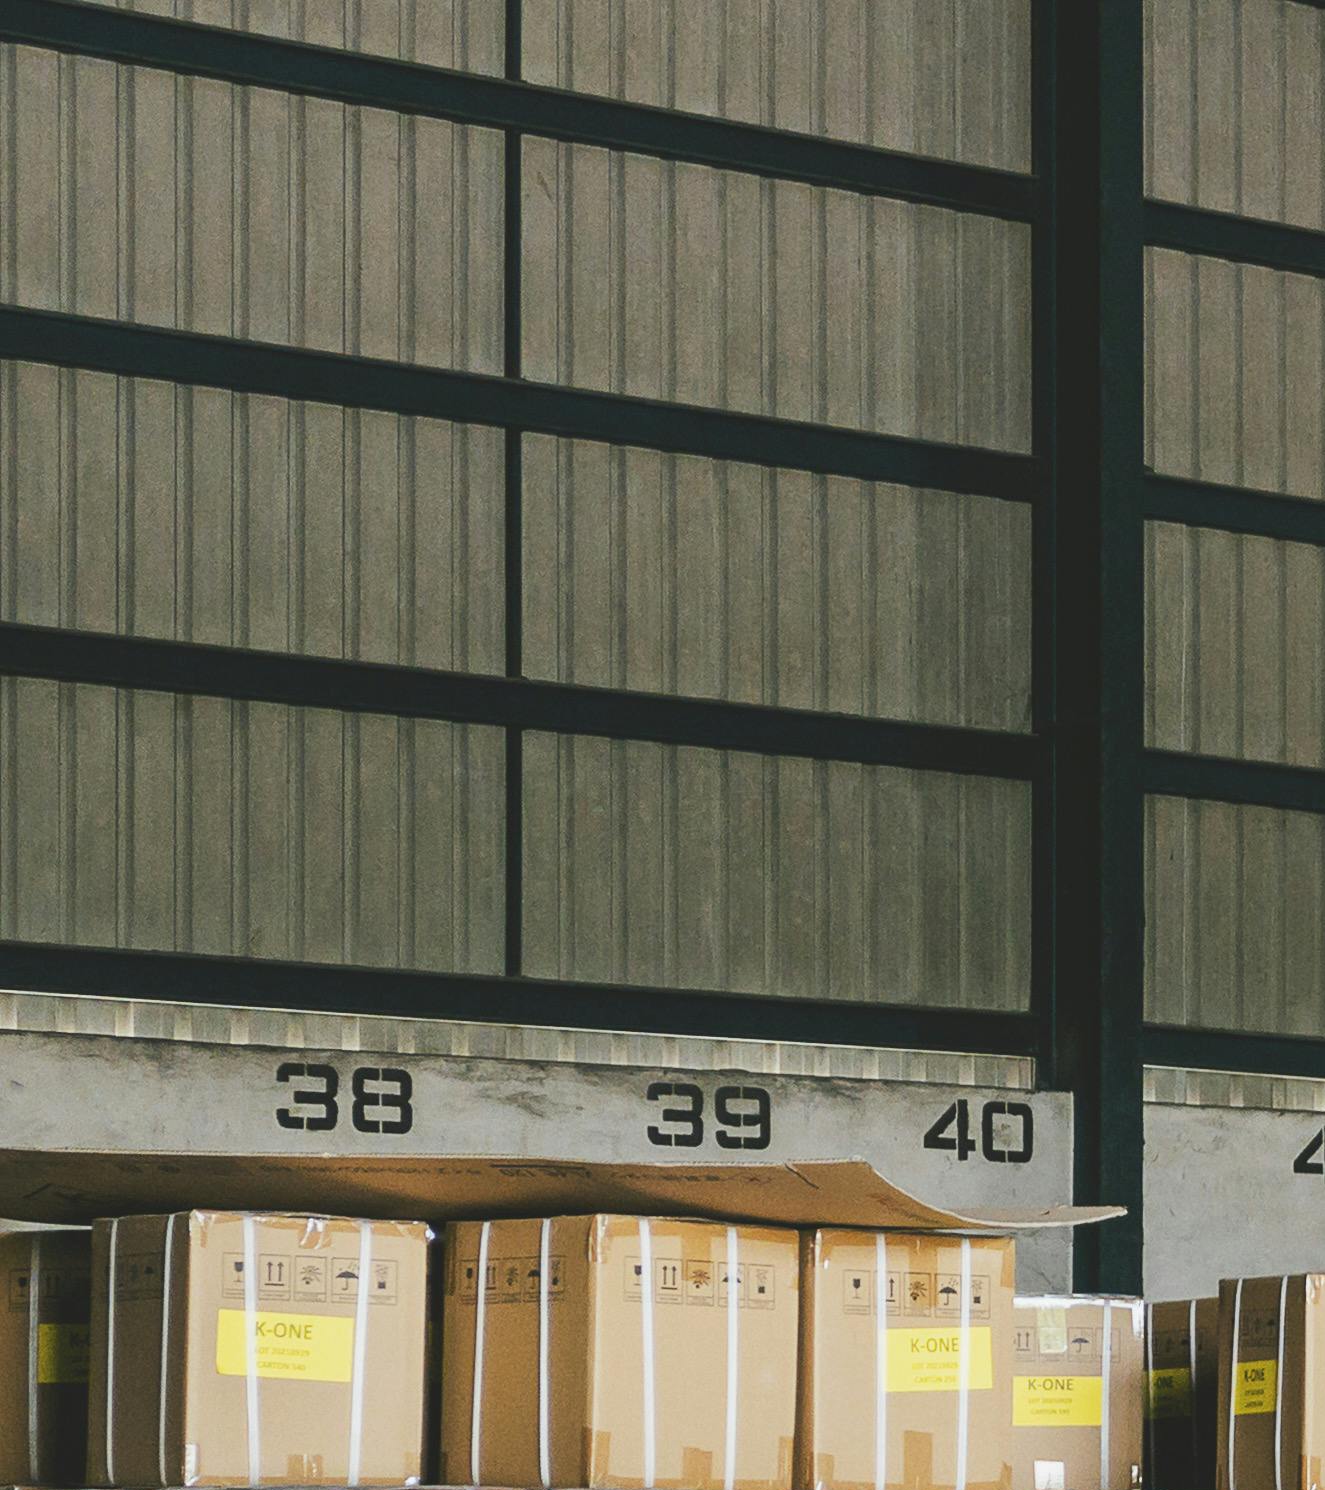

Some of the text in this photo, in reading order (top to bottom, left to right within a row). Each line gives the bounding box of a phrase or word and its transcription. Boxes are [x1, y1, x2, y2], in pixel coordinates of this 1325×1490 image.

[276, 1062, 413, 1136] 38
[647, 1081, 771, 1151] 39
[923, 1099, 1034, 1165] 40
[255, 1321, 313, 1340] K-ONE
[911, 1337, 960, 1353] K-ONE
[1243, 1367, 1265, 1382] K-ONE
[1027, 1378, 1075, 1392] K-ONE
